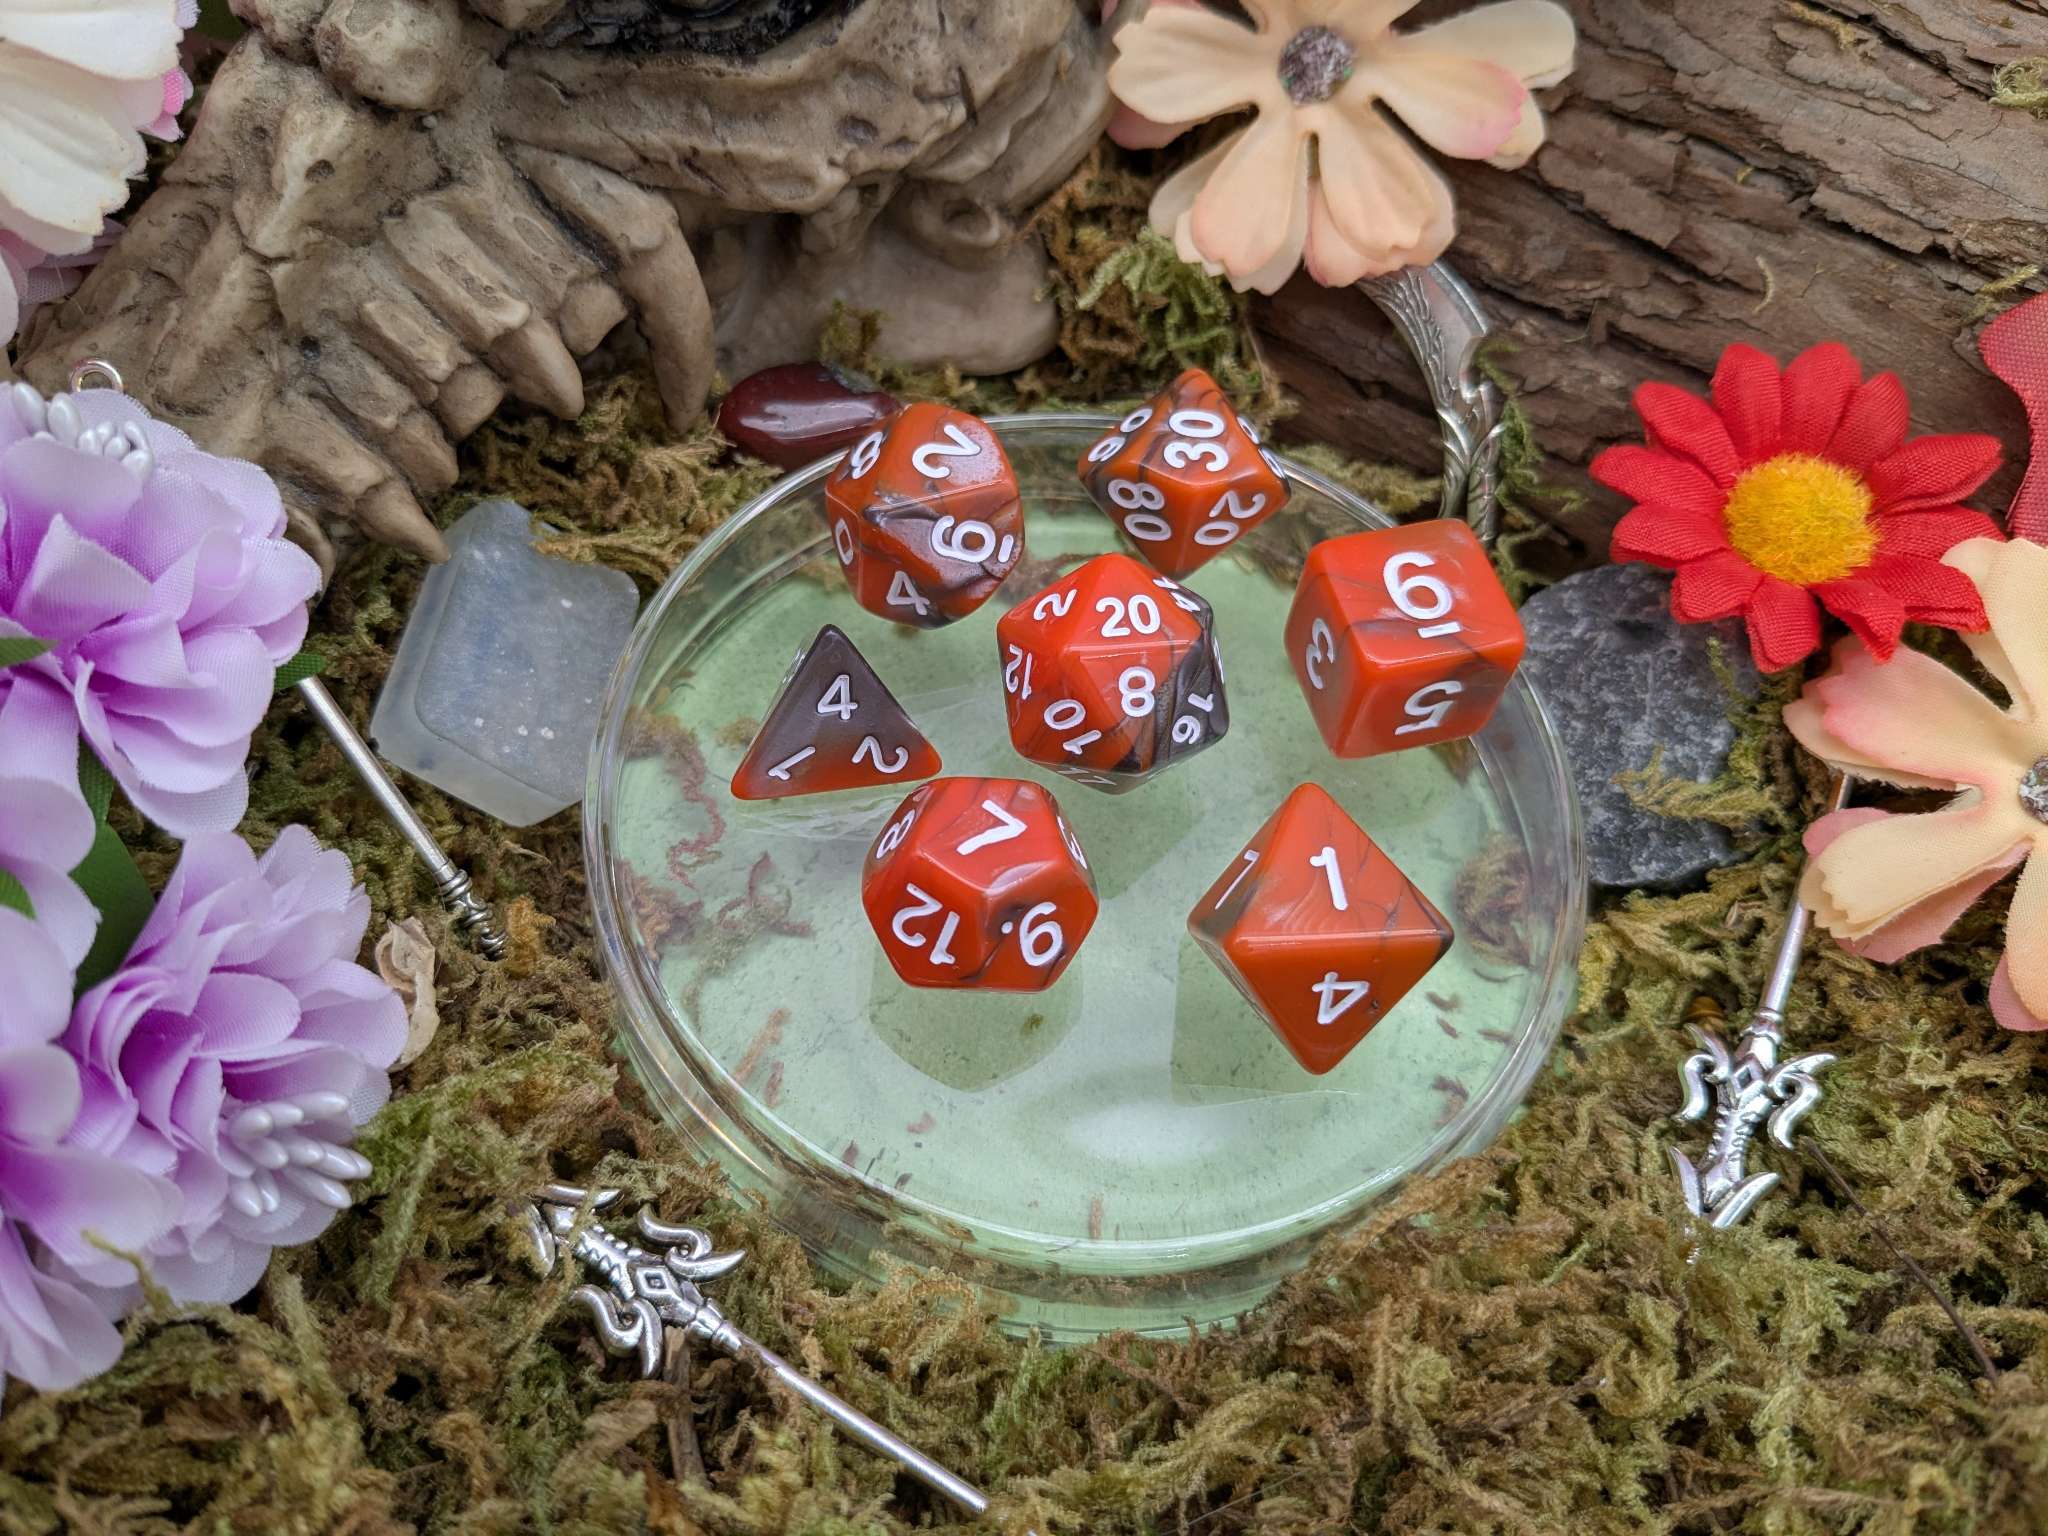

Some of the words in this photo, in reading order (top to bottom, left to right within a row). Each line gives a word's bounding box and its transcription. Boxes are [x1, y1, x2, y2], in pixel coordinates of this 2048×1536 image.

[851, 431, 883, 479] 8
[912, 425, 981, 479] 2
[1163, 410, 1229, 472] 30
[1108, 479, 1172, 541] 80
[1194, 490, 1266, 546] 20
[835, 519, 854, 565] 0
[886, 571, 930, 615] 4
[1033, 589, 1078, 620] 2
[1095, 594, 1161, 637] 20
[1005, 644, 1032, 700] 12
[1305, 616, 1336, 691] 3
[817, 674, 858, 720] 4
[1118, 666, 1156, 717] 8
[1395, 680, 1464, 736] 5
[1044, 699, 1102, 755] 10
[1172, 693, 1214, 745] 16
[768, 746, 816, 780] 1
[851, 735, 909, 774] 2
[876, 809, 916, 859] 8
[956, 800, 1028, 856] 7
[1309, 846, 1348, 910] 1
[892, 883, 960, 965] 12
[1312, 972, 1370, 1025] 4
